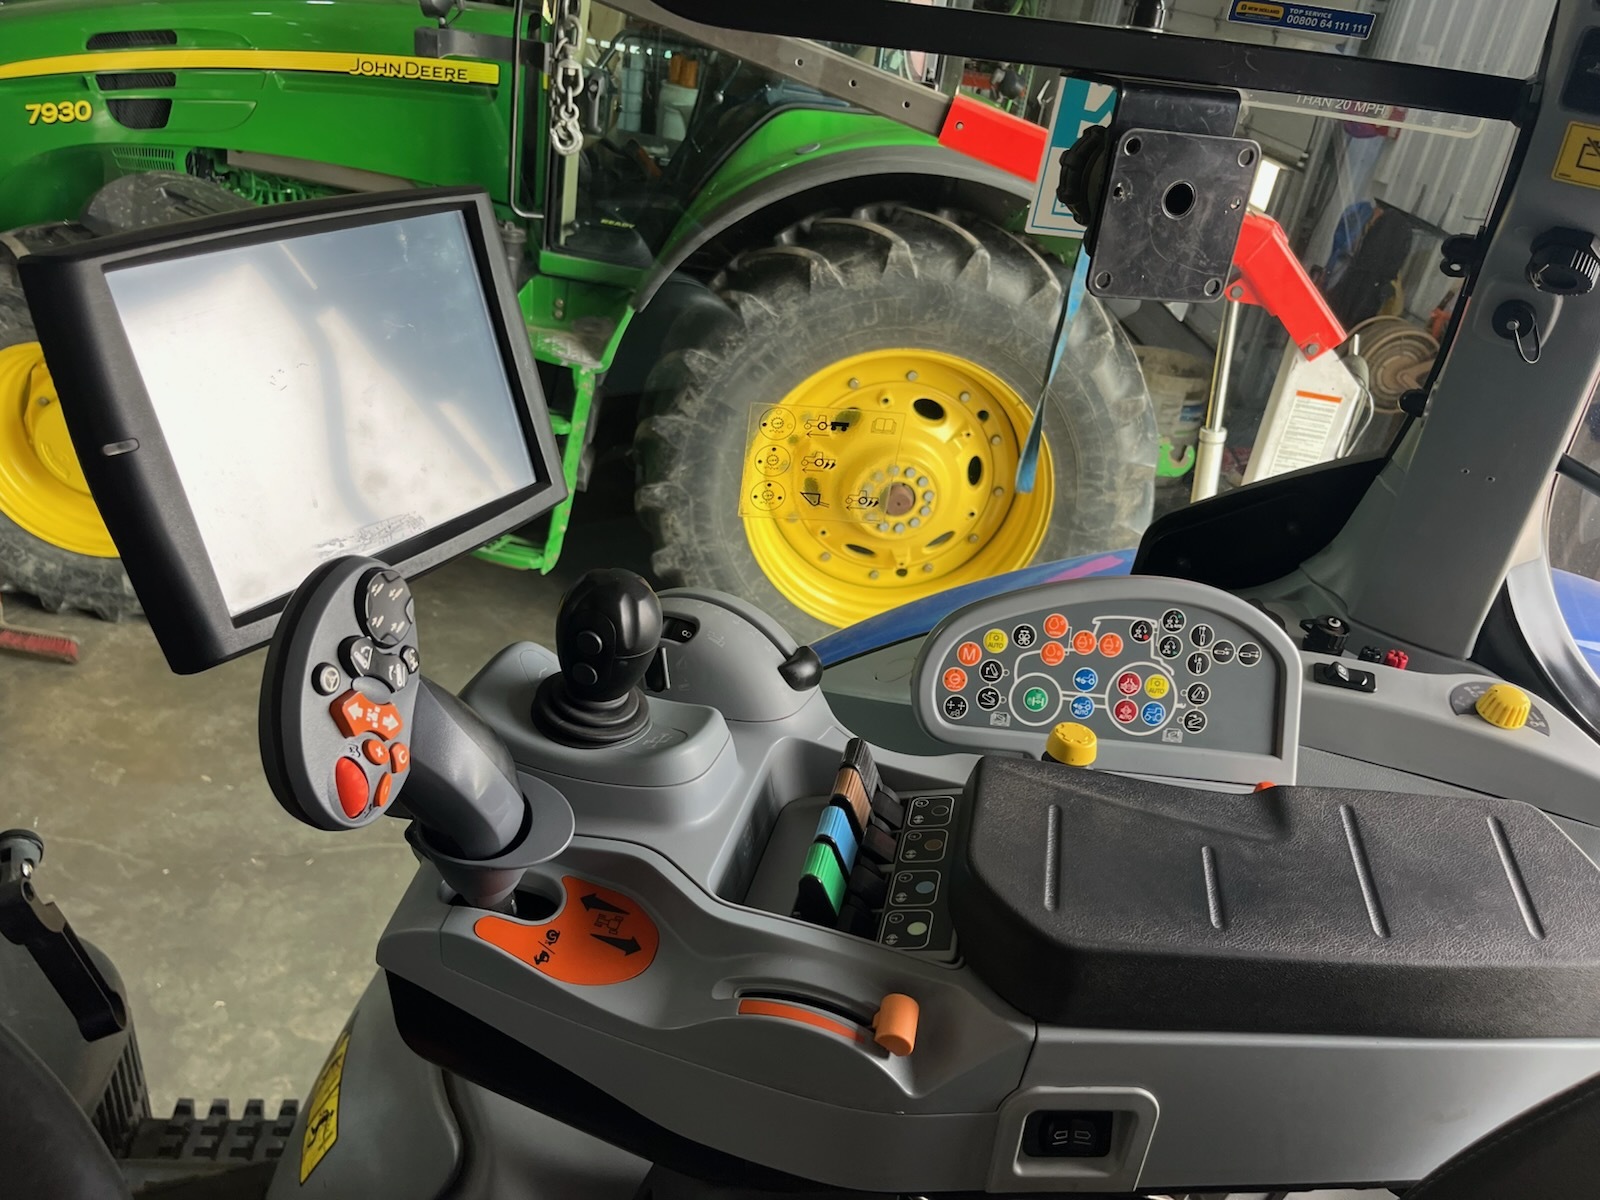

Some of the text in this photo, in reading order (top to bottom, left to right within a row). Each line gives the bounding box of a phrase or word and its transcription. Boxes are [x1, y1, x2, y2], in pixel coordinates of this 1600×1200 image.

[1289, 7, 1332, 19] TOP SERVICE
[1286, 14, 1368, 34] 00800 64 111 111
[350, 58, 468, 81] JOHN DEERE
[25, 100, 92, 125] 7930
[1296, 94, 1387, 115] THAN 20 MPH
[962, 647, 976, 661] M
[987, 642, 1004, 650] AUTO
